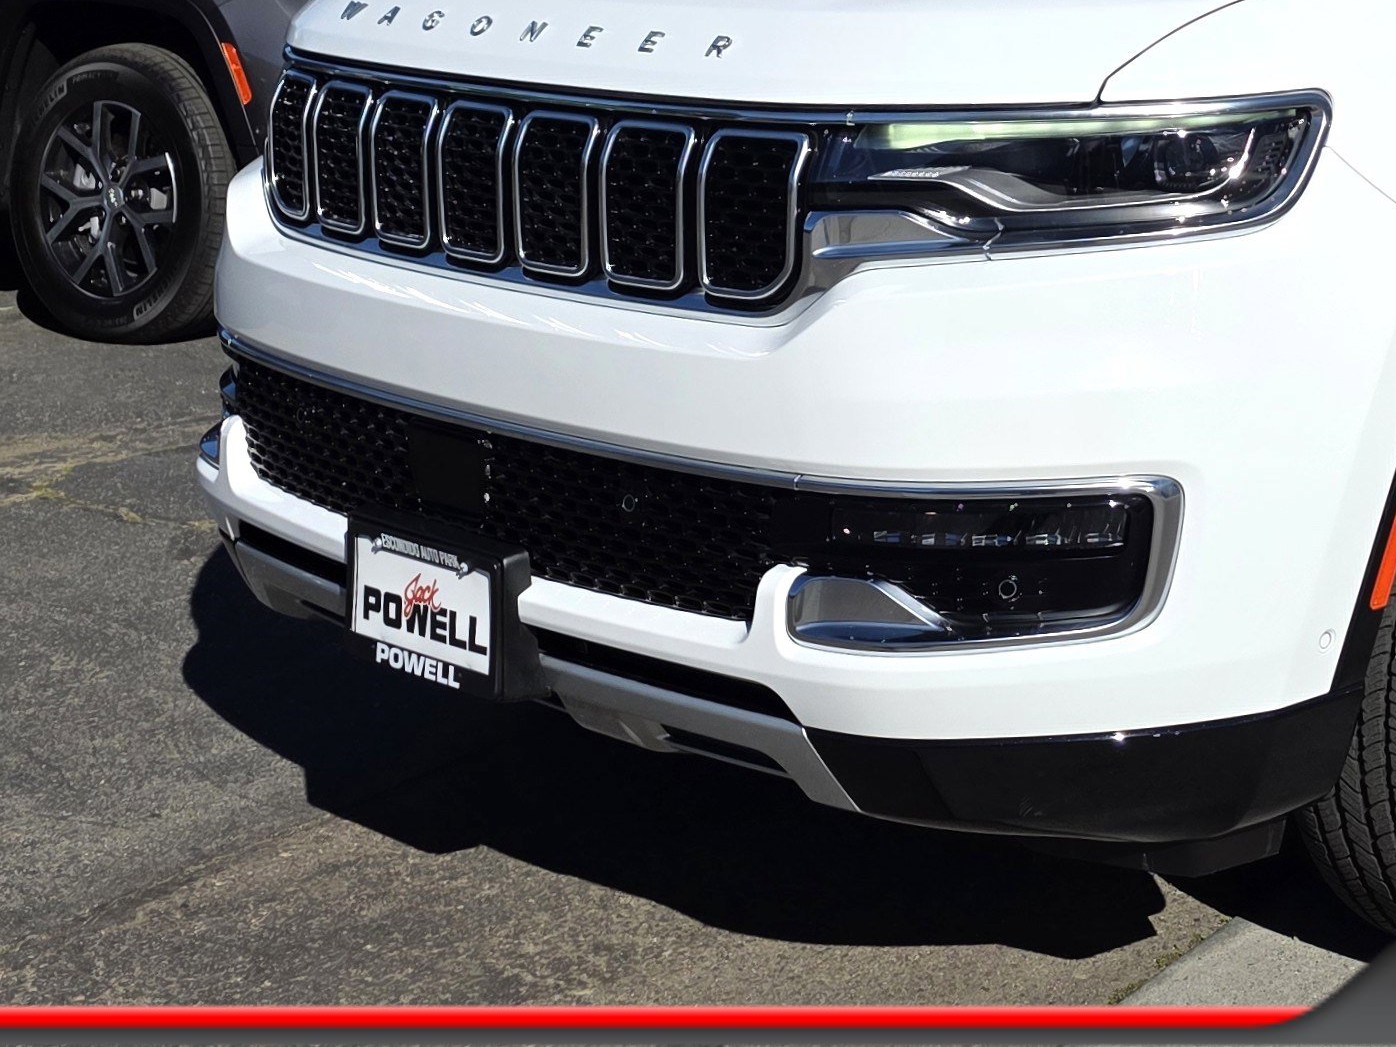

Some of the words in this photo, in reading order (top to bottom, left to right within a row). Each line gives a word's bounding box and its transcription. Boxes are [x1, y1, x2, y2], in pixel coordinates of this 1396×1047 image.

[340, 0, 733, 58] WAGONEER
[381, 532, 421, 558] ESCONDIDO
[420, 545, 440, 563] AUTO
[439, 550, 461, 570] PARK
[404, 572, 441, 619] Jack
[362, 584, 488, 657] POWELL
[375, 641, 461, 690] POWELL
